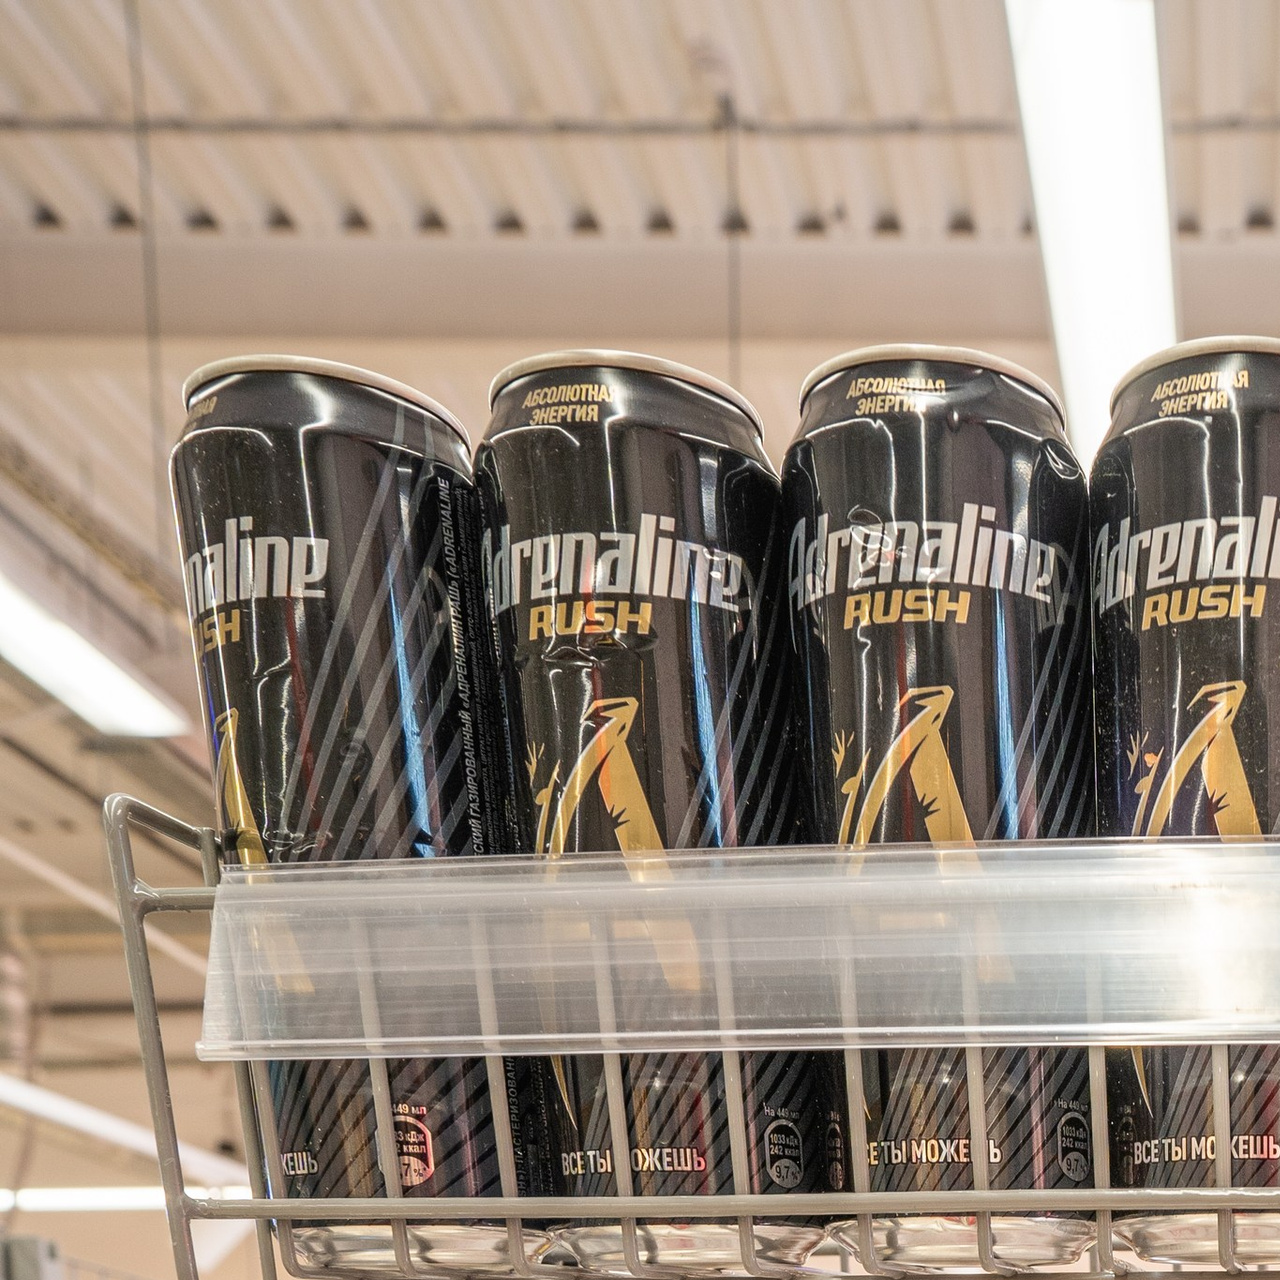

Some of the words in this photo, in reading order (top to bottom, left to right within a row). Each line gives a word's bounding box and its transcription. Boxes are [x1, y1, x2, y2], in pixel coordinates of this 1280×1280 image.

[522, 384, 618, 409] АБСОЛЮТНАЯ
[846, 376, 947, 400] АБСОЛЮТНАЯ
[1151, 370, 1249, 402] АБСОЛЮТНАЯ
[530, 404, 599, 426] ЭНЕРГИЯ
[855, 395, 926, 416] ЭНЕРГИЯ
[1158, 390, 1228, 418] ЭНЕРГИЯ
[481, 513, 745, 617] Adrenaline
[787, 502, 1056, 640] Adrenaline
[447, 580, 465, 617] РАШ»
[843, 588, 971, 630] RUSH
[1141, 584, 1267, 631] RUSH
[529, 600, 653, 641] RUSH
[449, 619, 473, 708] «АДРЕНАЛИН
[457, 711, 480, 817] ГАЗИРОВАННЫЙ
[561, 1151, 585, 1175] ВСЕ
[587, 1149, 612, 1173] ТЫ
[631, 1147, 706, 1172] ОЖЕШЬ
[881, 1139, 907, 1164] ТЫ
[911, 1137, 1002, 1164] МОЖЕЬ
[1134, 1139, 1160, 1165] ВСЕ
[1161, 1136, 1187, 1162] ТЫ
